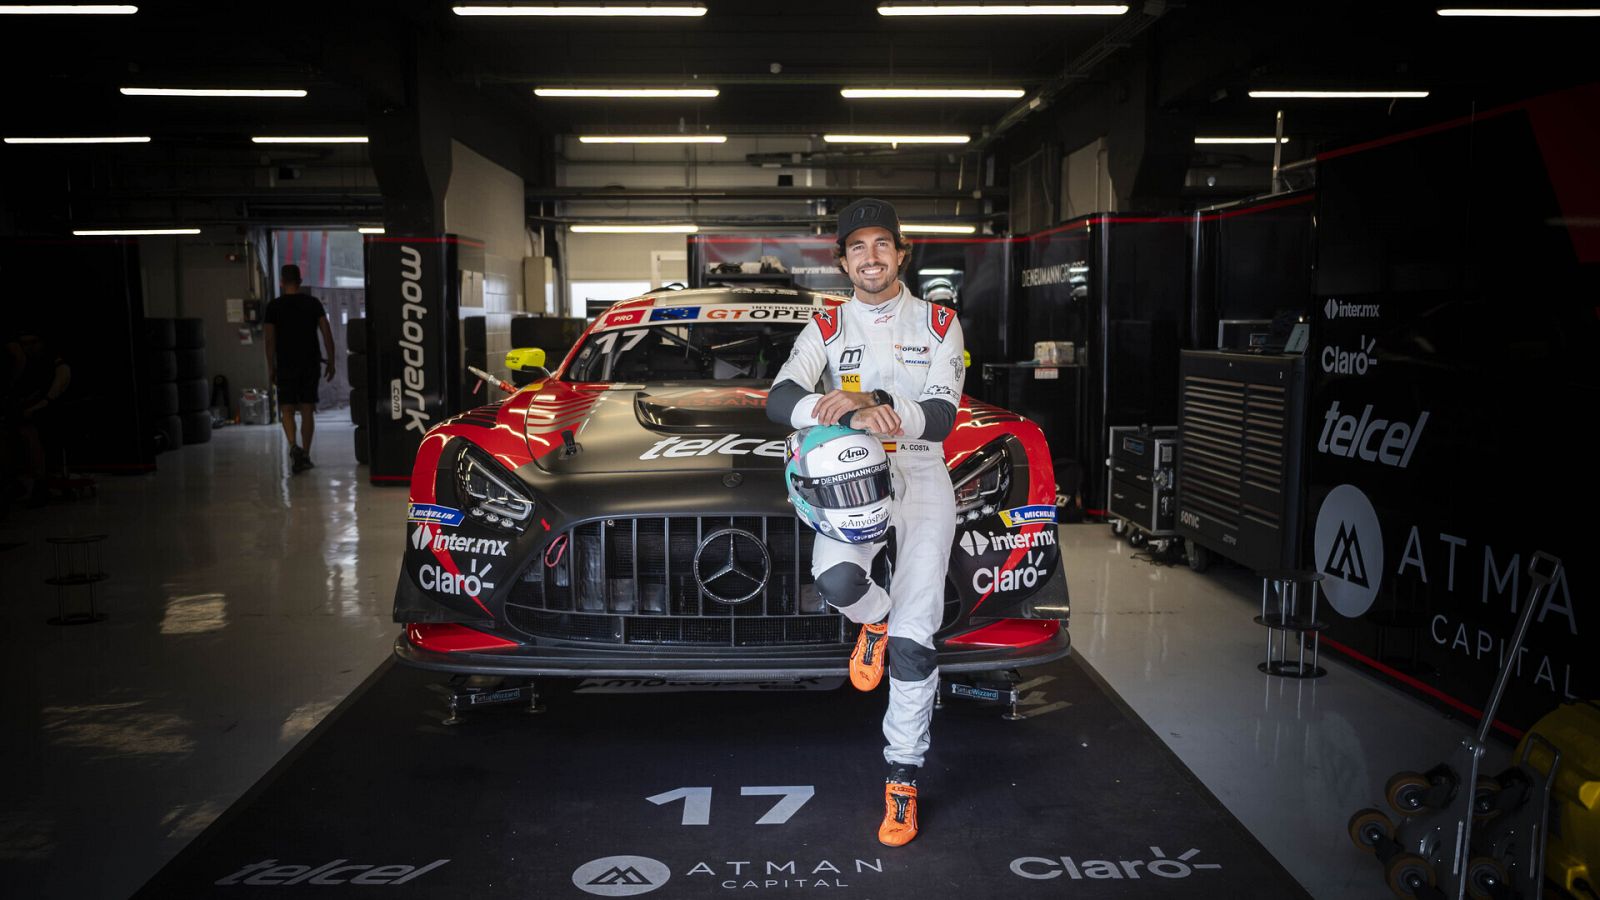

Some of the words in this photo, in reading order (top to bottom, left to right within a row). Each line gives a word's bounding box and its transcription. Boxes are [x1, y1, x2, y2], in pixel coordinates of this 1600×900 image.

[613, 313, 634, 323] PRO
[1338, 300, 1381, 318] inter.mx
[399, 244, 431, 435] motopark
[595, 329, 650, 354] 17
[1321, 339, 1372, 375] Claro
[841, 374, 860, 384] RACC
[639, 433, 785, 460] telce
[900, 443, 908, 451] A.
[909, 444, 930, 452] COSTA
[1317, 400, 1430, 469] telcel
[842, 448, 865, 460] Arai
[414, 509, 455, 520] MICHELIN
[1024, 510, 1056, 519] MICHELIN
[433, 528, 509, 557] inter.mx
[988, 530, 1056, 551] inter.mx
[419, 562, 487, 597] Claro
[973, 560, 1042, 594] Claro
[1431, 613, 1580, 700] CAPITAL
[645, 785, 815, 826] 17
[214, 858, 451, 885] telcel
[686, 858, 883, 876] ATMAN
[1009, 851, 1207, 879] Claro
[721, 878, 849, 888] CAPITAL
